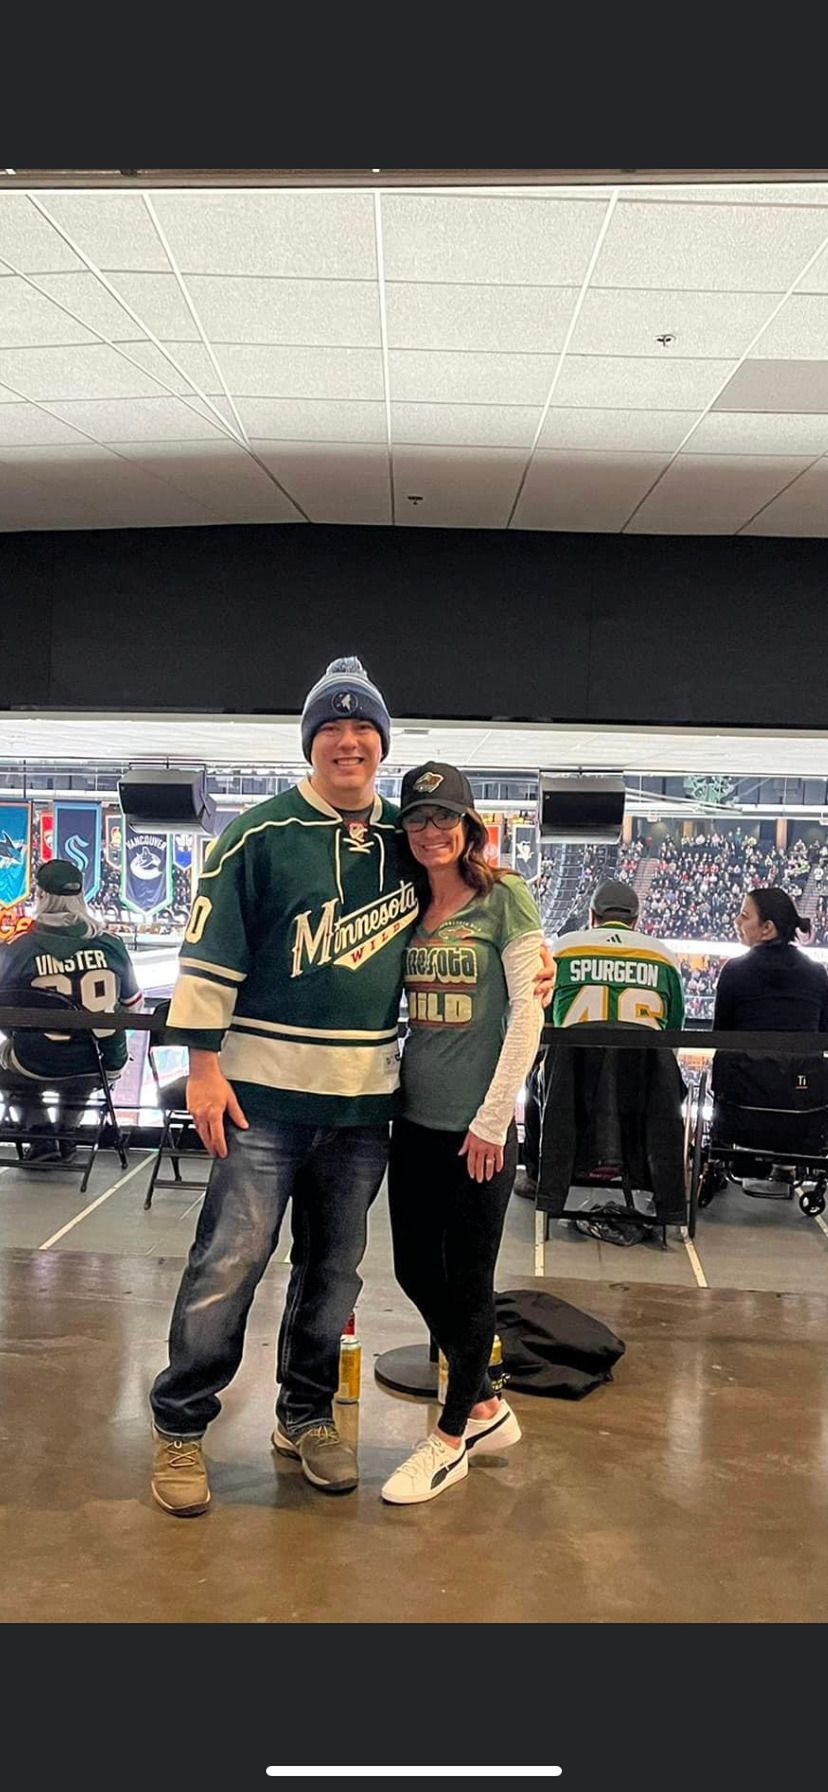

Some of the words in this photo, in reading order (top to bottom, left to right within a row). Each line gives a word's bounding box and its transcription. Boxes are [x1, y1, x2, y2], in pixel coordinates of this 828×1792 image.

[126, 835, 167, 851] VANCOUVER
[290, 880, 419, 978] Minnesota
[351, 922, 401, 963] WILD
[570, 959, 659, 987] SPURGEON
